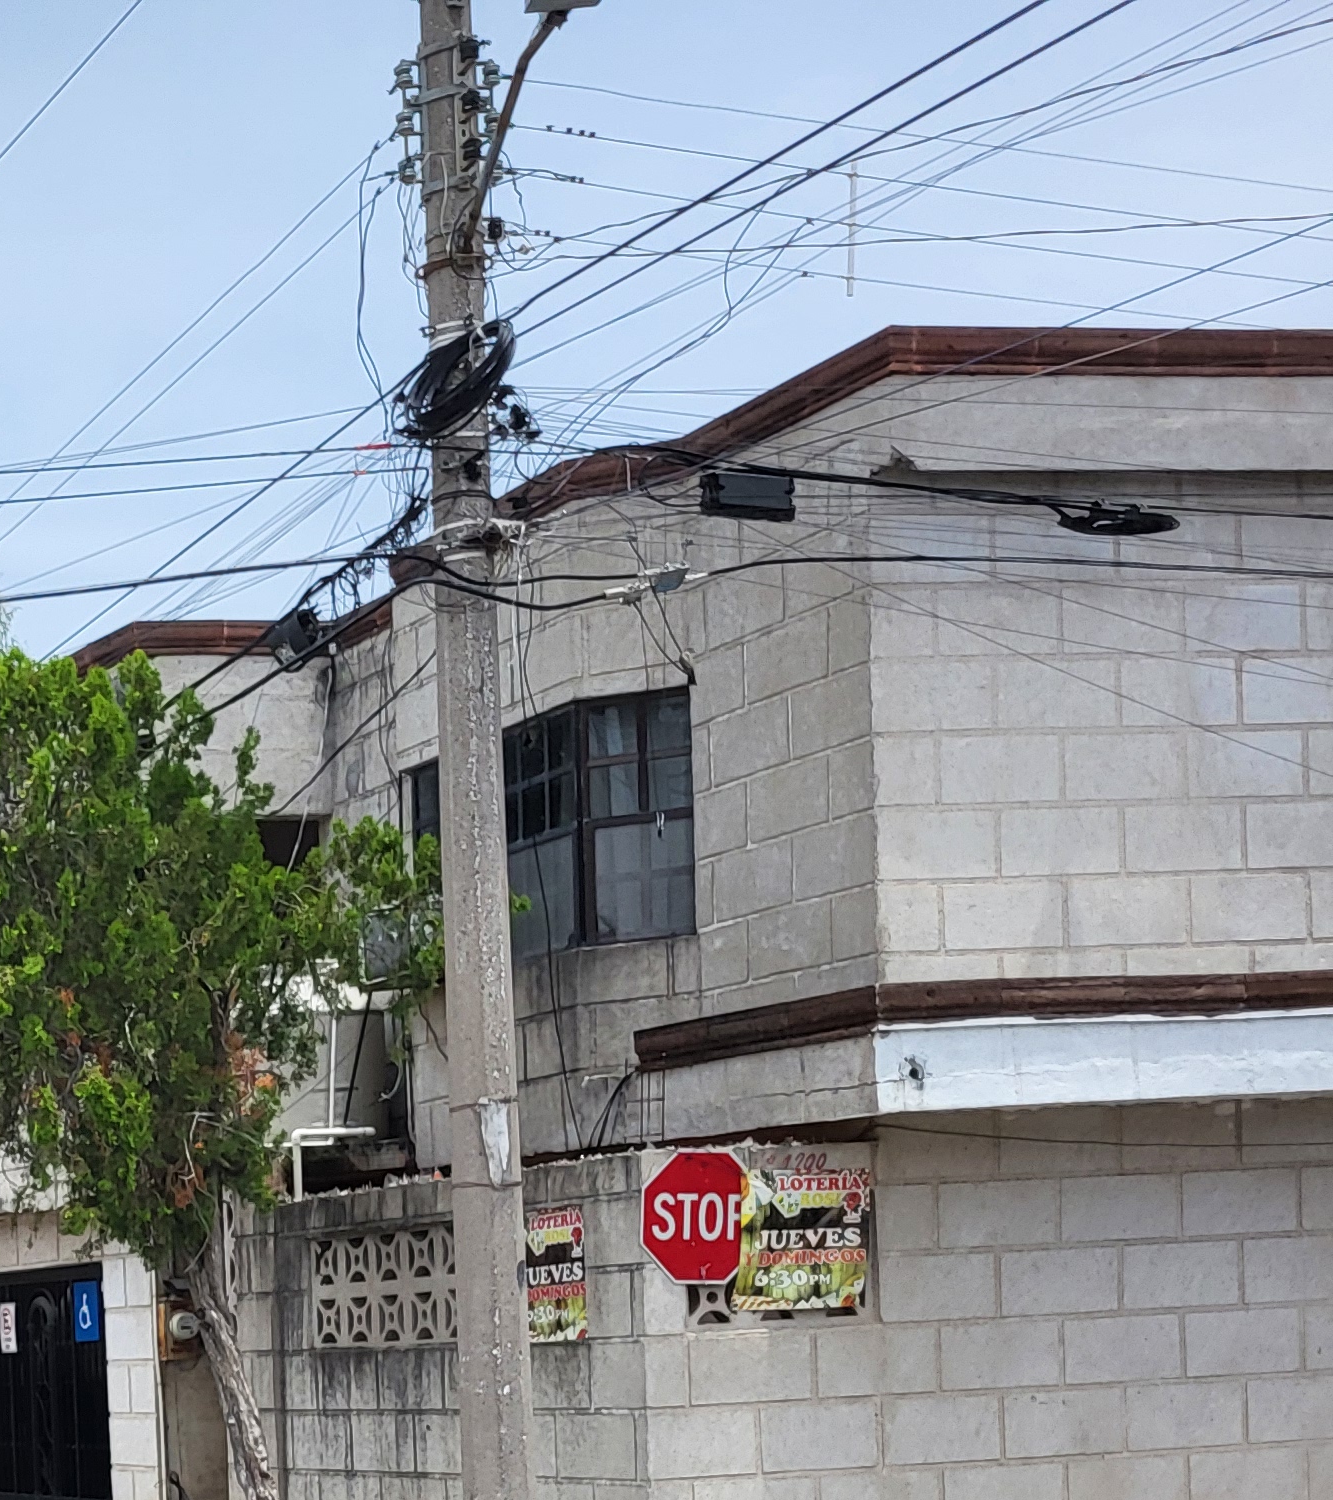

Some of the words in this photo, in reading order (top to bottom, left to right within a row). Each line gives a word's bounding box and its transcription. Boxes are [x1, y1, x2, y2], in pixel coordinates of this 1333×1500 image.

[755, 1228, 862, 1250] JUEVES
[757, 1248, 867, 1267] DOMINGOS
[526, 1261, 583, 1286] UEVES
